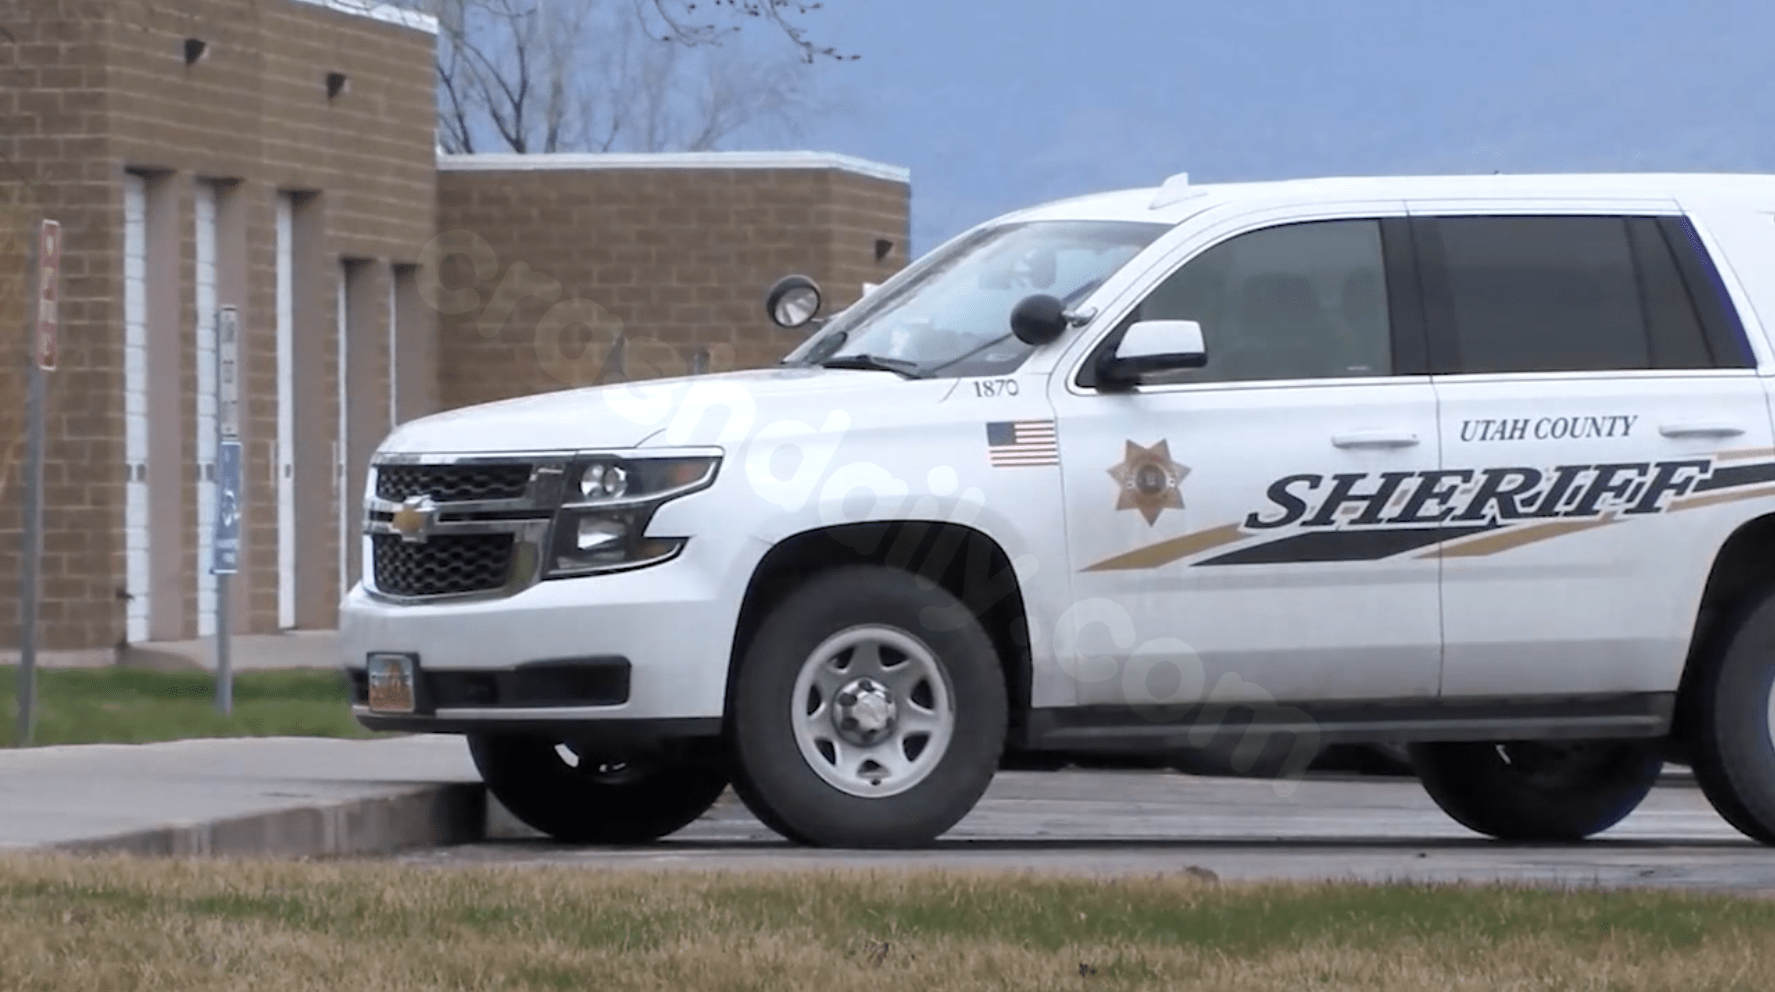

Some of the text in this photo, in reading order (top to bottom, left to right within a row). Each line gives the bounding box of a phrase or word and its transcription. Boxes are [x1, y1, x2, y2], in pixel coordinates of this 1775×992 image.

[974, 379, 1020, 397] 1870
[1460, 415, 1638, 442] UTAH COUNTY
[1244, 459, 1711, 528] SHERIFF
